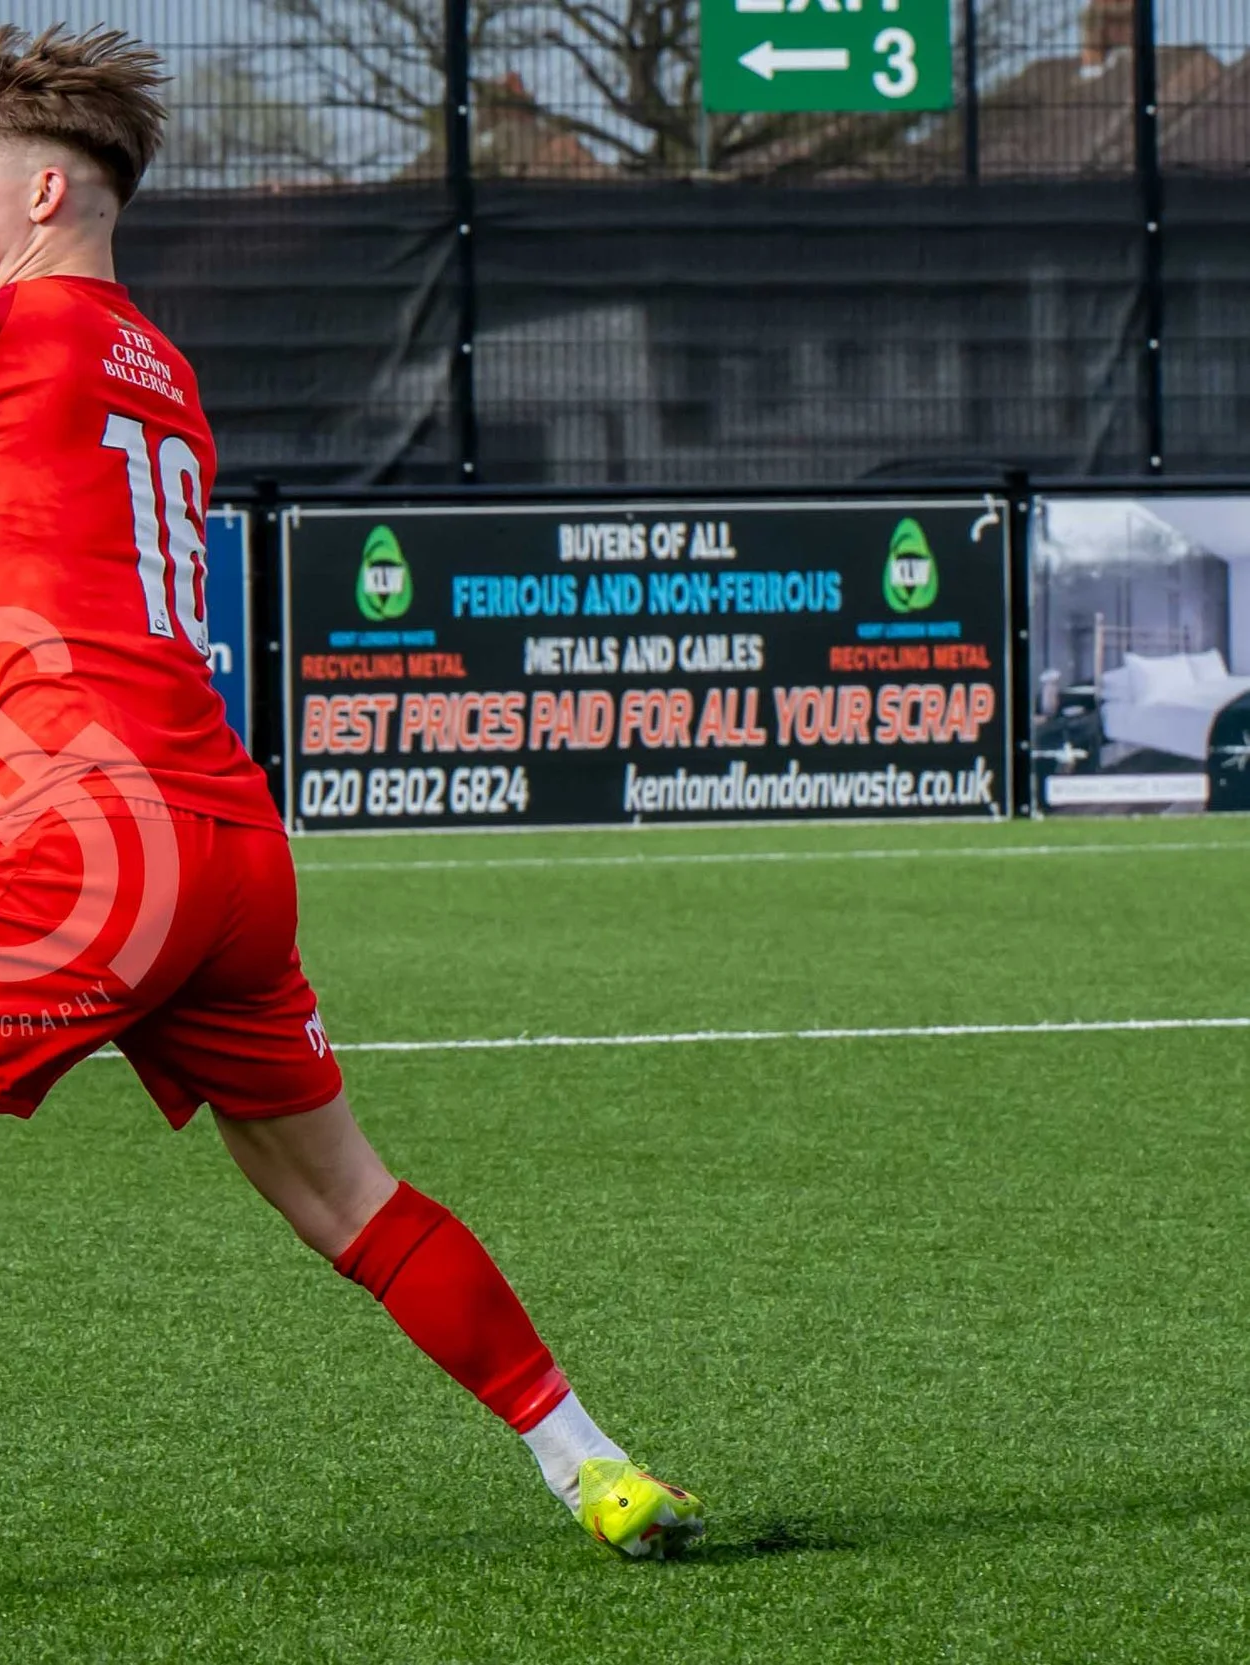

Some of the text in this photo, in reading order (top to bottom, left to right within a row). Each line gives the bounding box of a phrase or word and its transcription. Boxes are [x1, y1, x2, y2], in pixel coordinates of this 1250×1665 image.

[873, 27, 918, 98] 3
[112, 344, 171, 381] CROWN
[118, 328, 156, 355] THE
[102, 359, 185, 406] BILLERICAY
[558, 522, 736, 561] BUYERS OF ALL
[452, 571, 841, 617] FERROUS AND NON-FERROUS
[302, 653, 467, 680] RECYCLING METAL
[524, 634, 764, 674] METALS AND CABLES
[830, 644, 991, 671] RECYCLING METAL
[301, 683, 994, 755] BEST PRICES PAID FOR ALL YOUR SCRAP
[300, 766, 529, 820] 020 8302 6824
[624, 755, 992, 812] kentandlondonwaste.co.uk
